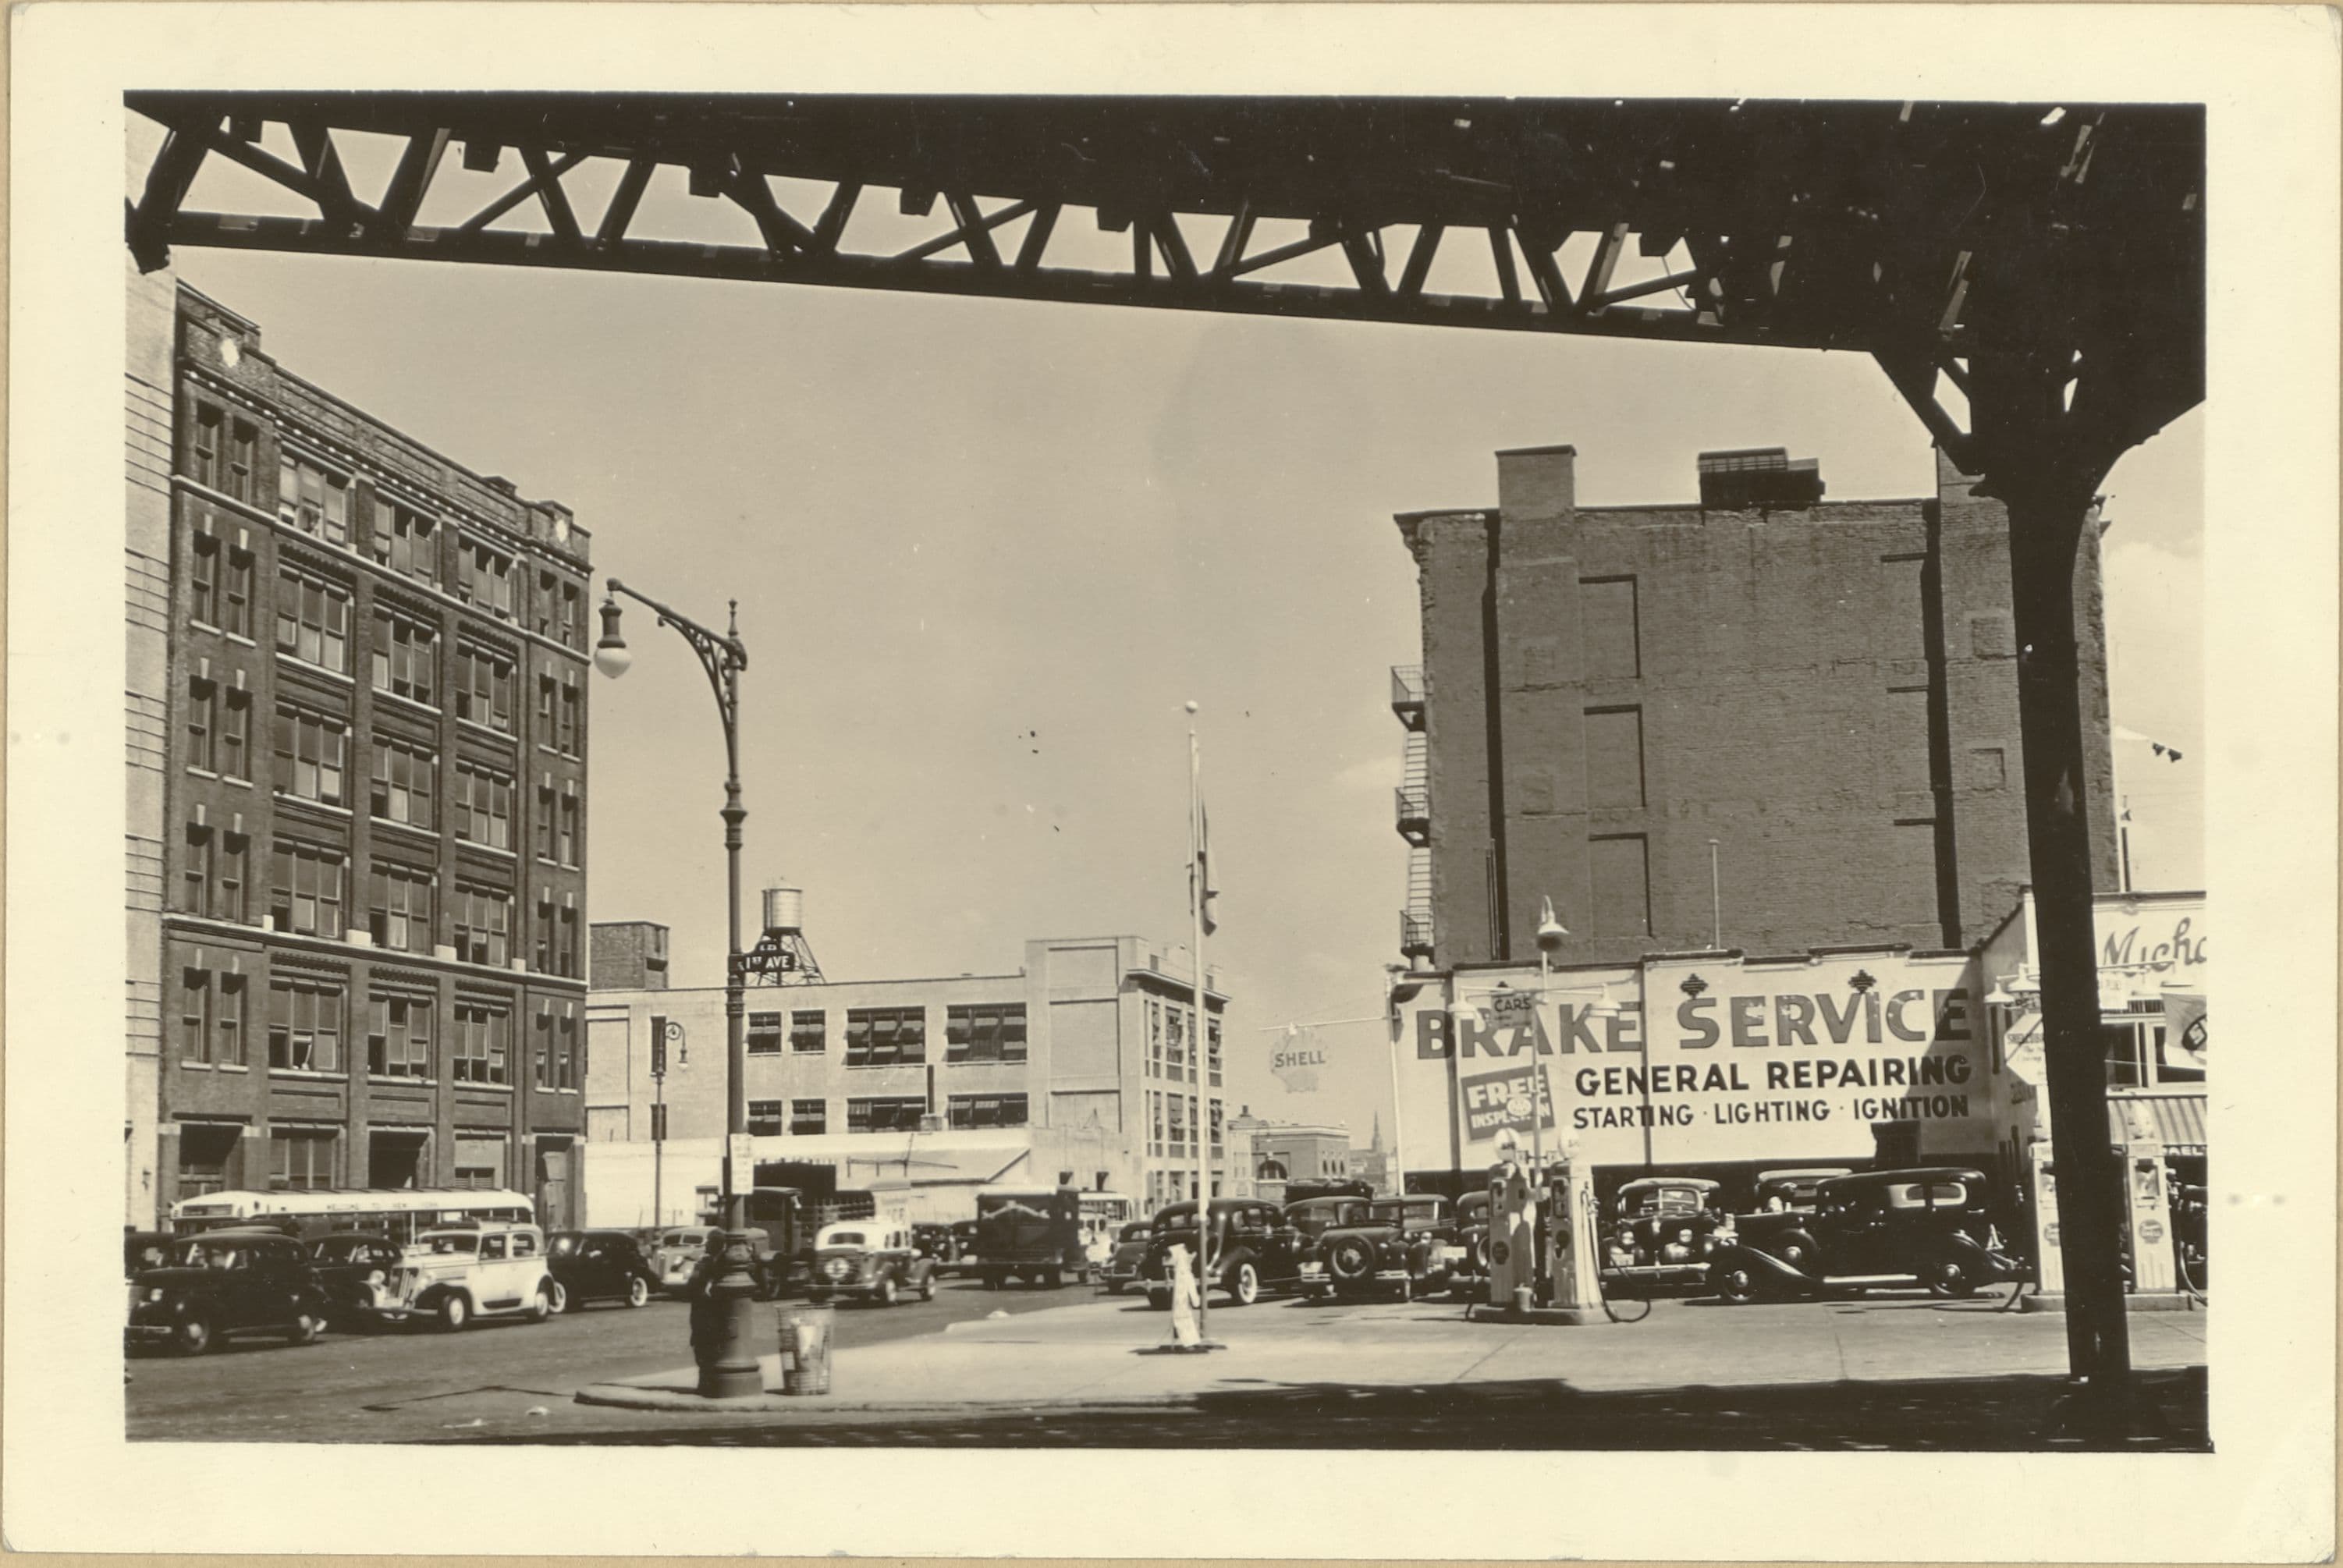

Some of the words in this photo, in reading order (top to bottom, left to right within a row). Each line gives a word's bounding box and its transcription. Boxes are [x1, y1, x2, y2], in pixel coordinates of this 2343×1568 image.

[765, 956, 790, 968] AVE
[1494, 998, 1532, 1012] CARS
[1417, 1000, 1642, 1059] BRAKE
[1677, 988, 1972, 1049] SERVICE
[1275, 1051, 1326, 1068] SHELL
[1575, 1062, 1749, 1096] GENERAL
[1767, 1055, 1972, 1091] REPAIRING
[1467, 1075, 1546, 1109] FREE
[1573, 1104, 1694, 1129] STARTING
[1714, 1098, 1830, 1124] LIGHTING
[1854, 1094, 1970, 1119] IGNITION
